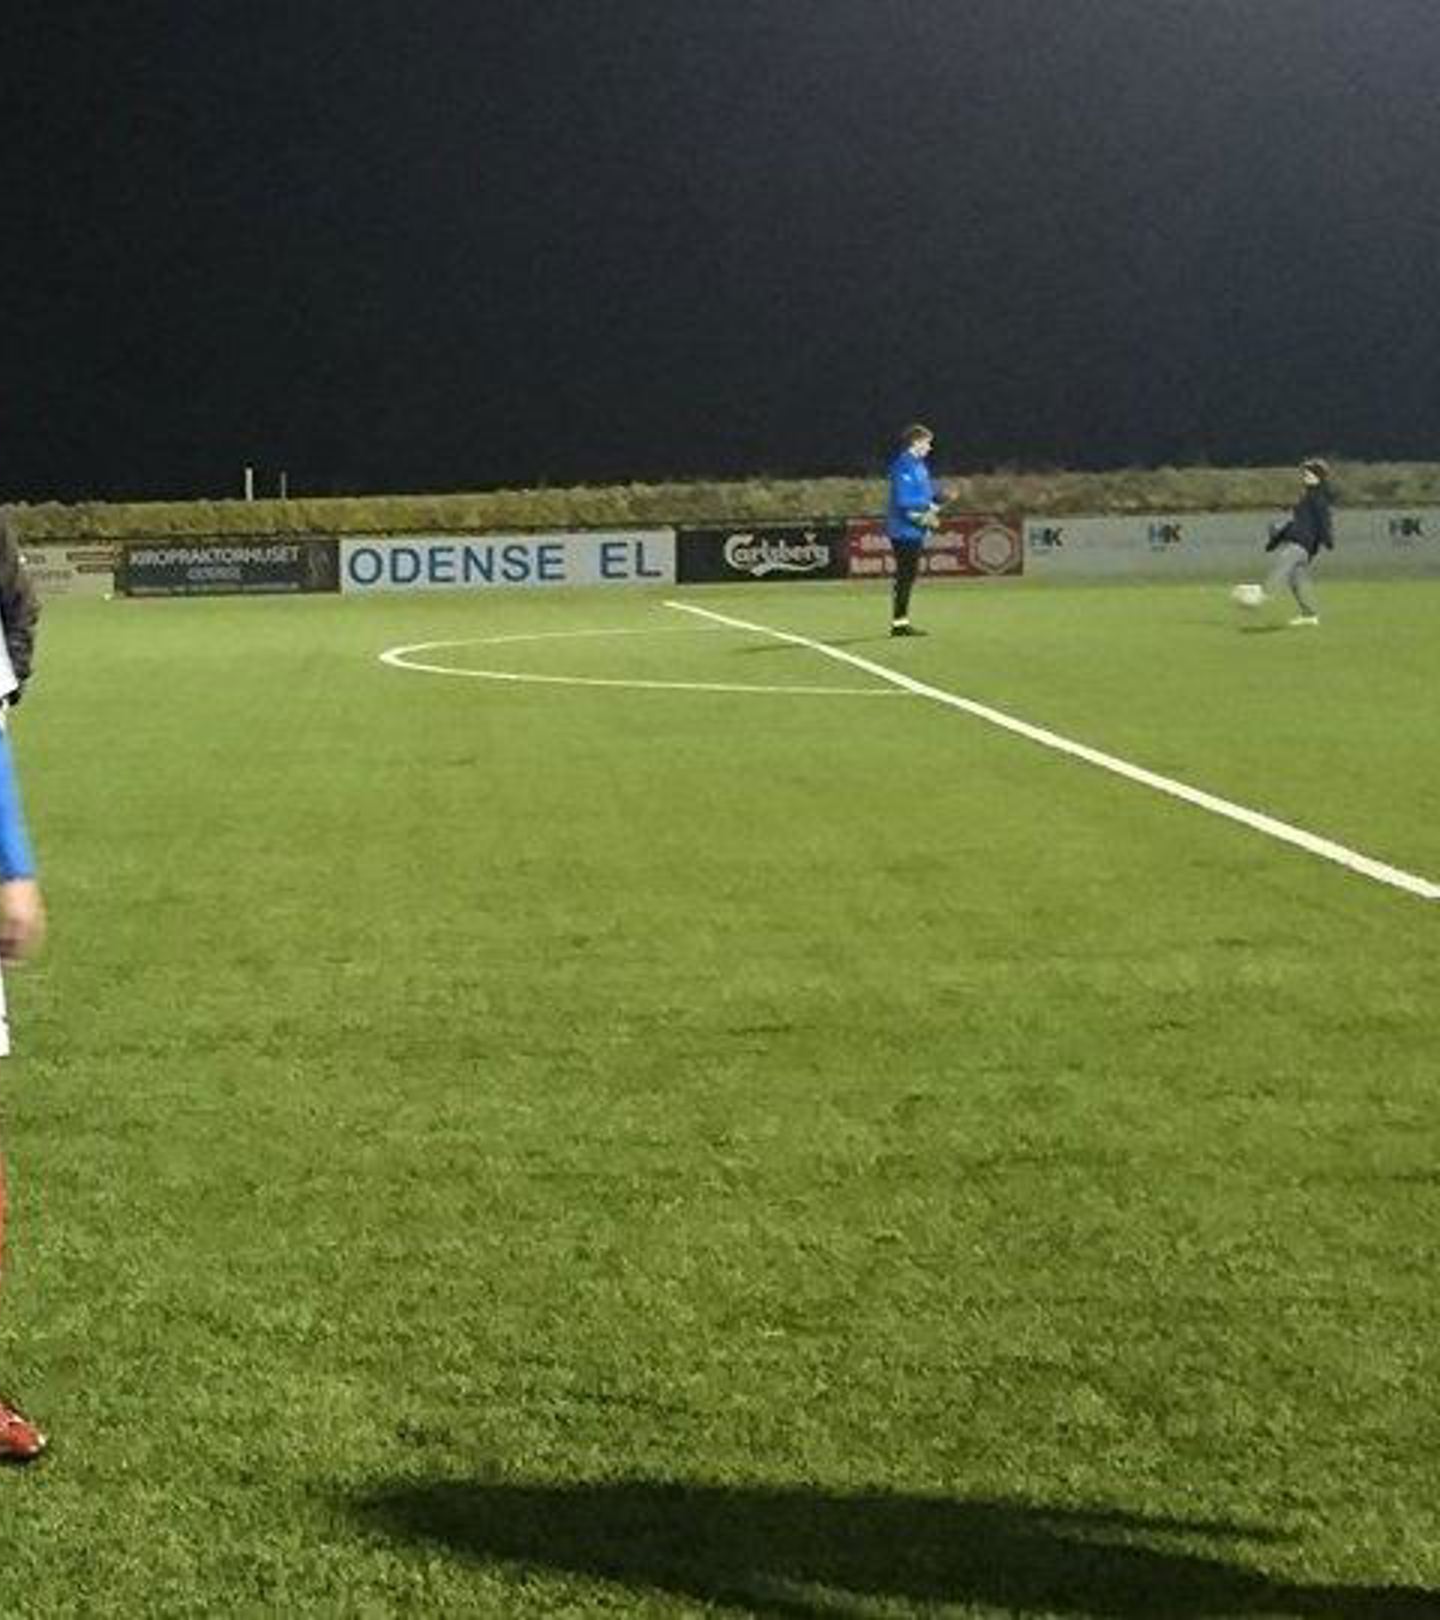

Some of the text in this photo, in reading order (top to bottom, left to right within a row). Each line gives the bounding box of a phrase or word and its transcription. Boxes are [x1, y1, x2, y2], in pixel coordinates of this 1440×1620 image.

[128, 546, 300, 566] KIROPRAKTORHUSET
[348, 541, 663, 585] ODENSE EL
[725, 531, 830, 577] Carlsberg
